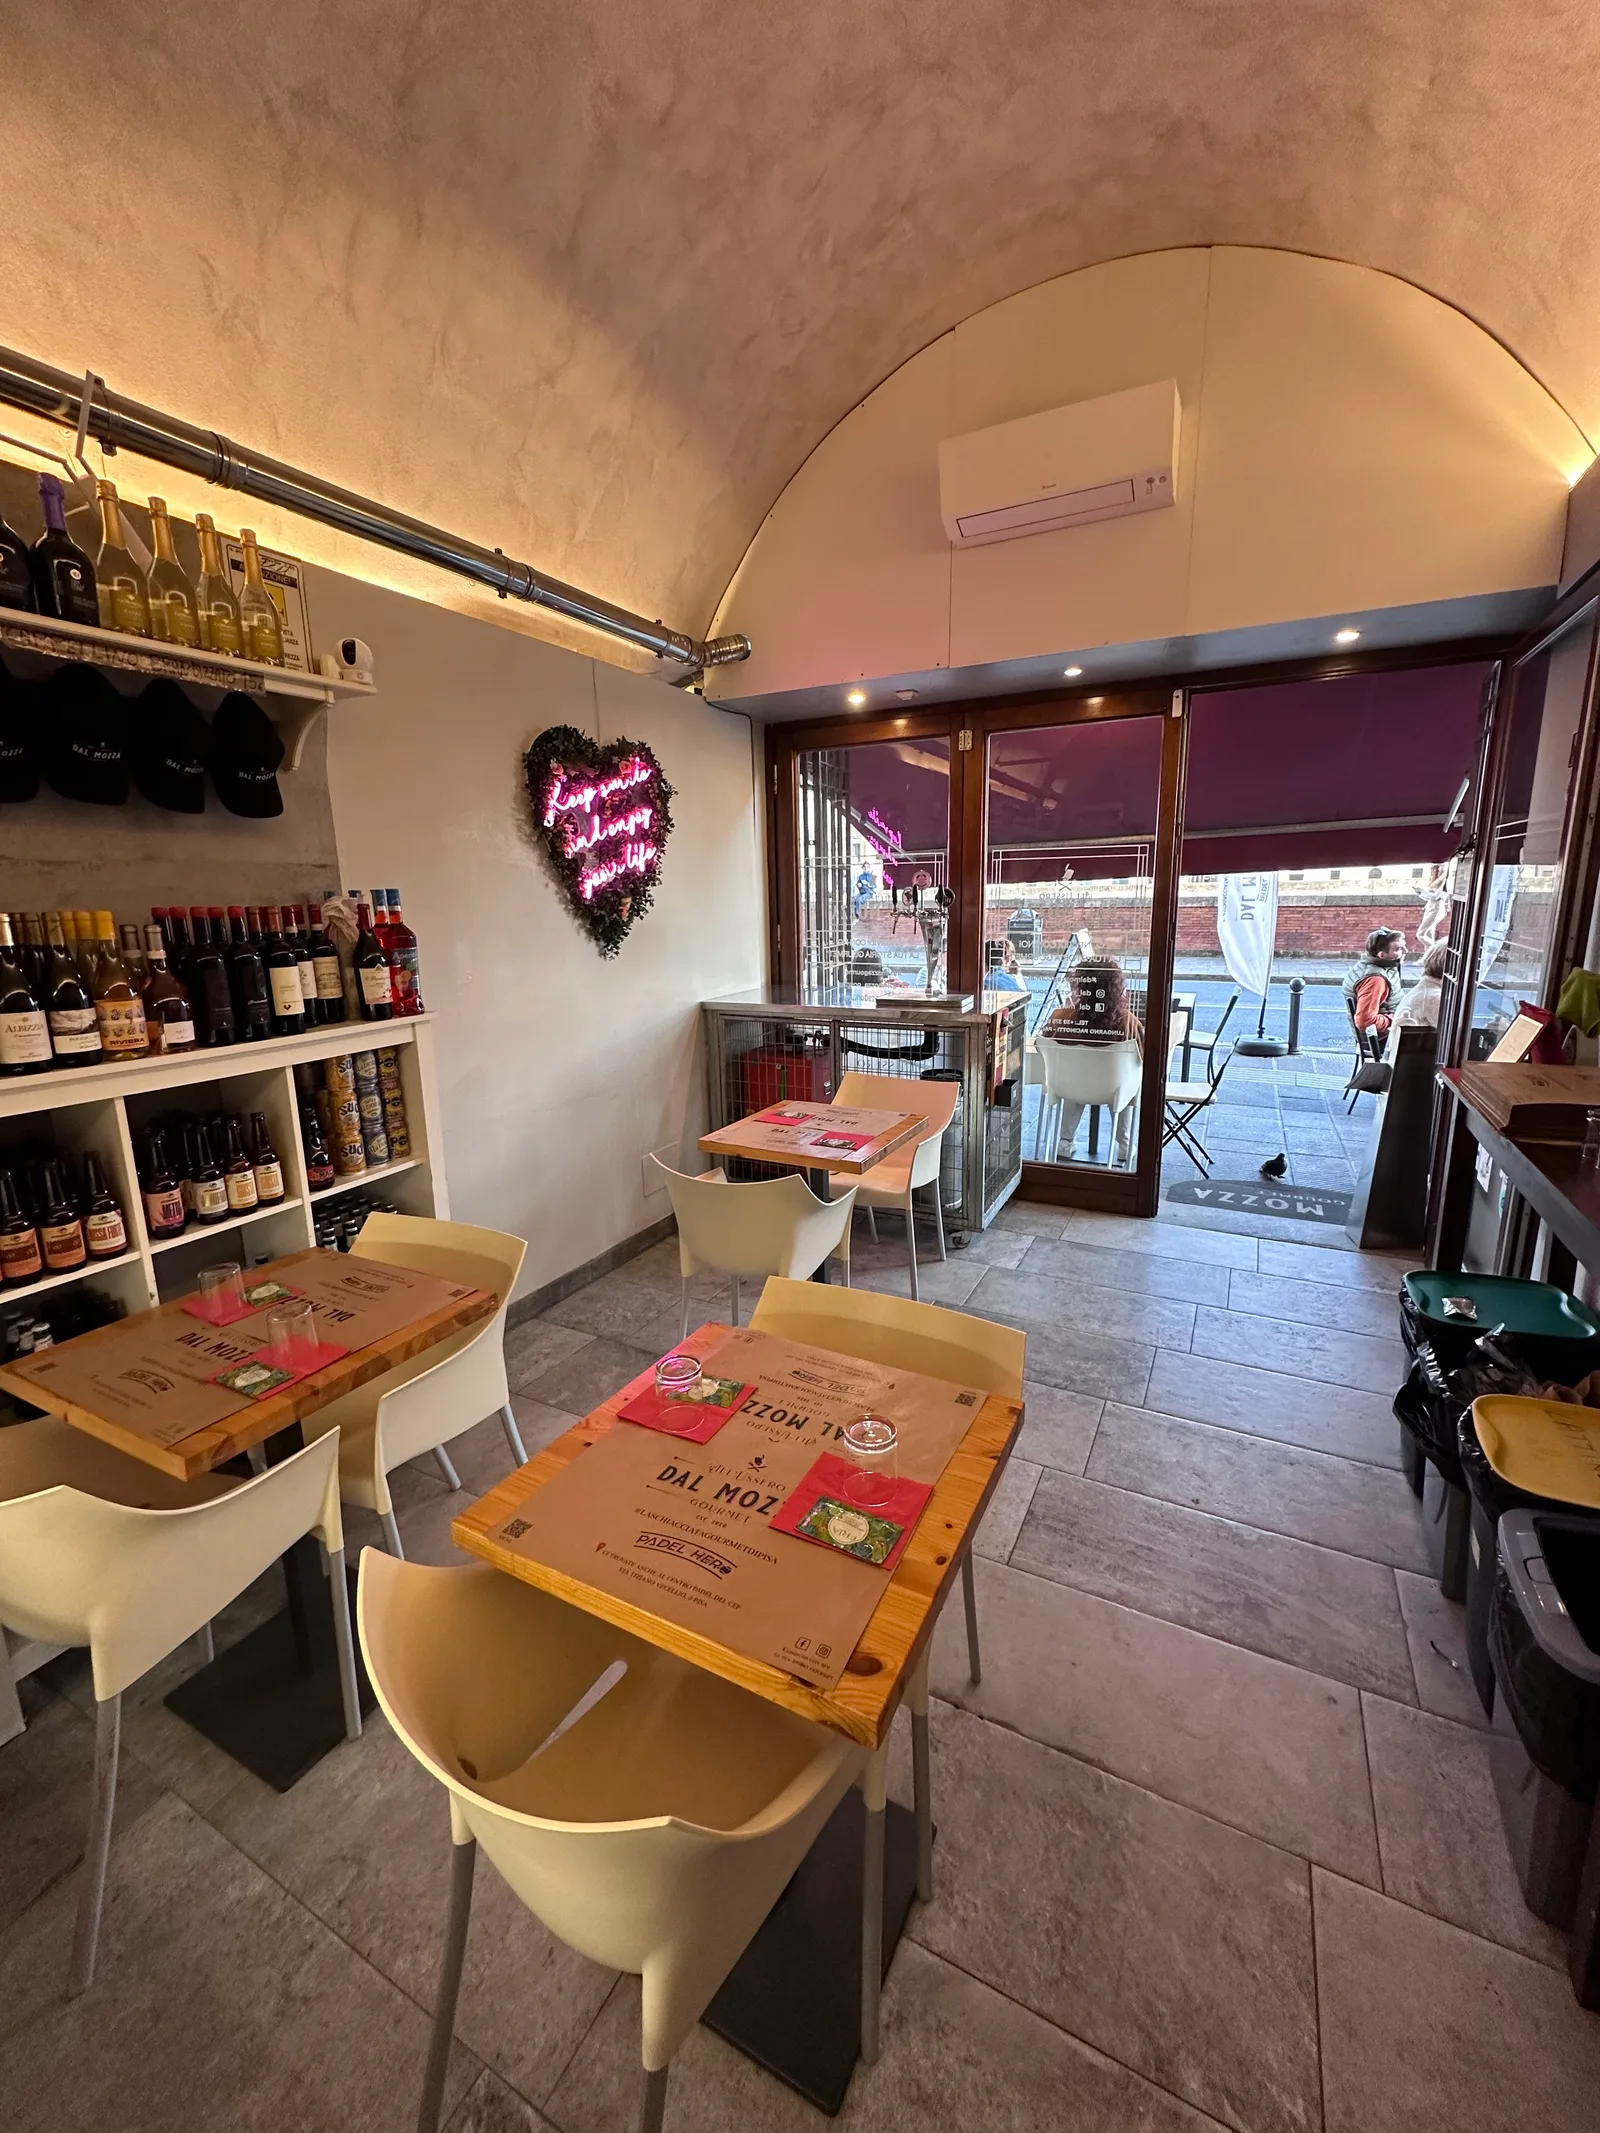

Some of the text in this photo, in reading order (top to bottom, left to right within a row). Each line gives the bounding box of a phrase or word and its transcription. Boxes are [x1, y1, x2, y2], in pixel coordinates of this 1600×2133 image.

[0, 747, 23, 757] OZZA
[72, 744, 121, 760] DAL MOZZA
[165, 759, 181, 770] DAL
[238, 771, 252, 780] DAL
[543, 780, 600, 828] Keep
[625, 842, 657, 873] life
[110, 1037, 145, 1046] RIVIERA
[1193, 1187, 1324, 1216] MOZZA
[322, 1308, 356, 1323] DAL
[176, 1331, 211, 1349] DAL
[740, 1399, 810, 1431] MOZZ
[820, 1421, 846, 1441] AL
[656, 1464, 786, 1519] DAL MOZ
[689, 1498, 752, 1523] GOURMET
[635, 1534, 686, 1555] PADEL
[666, 1574, 692, 1591] CENTRO
